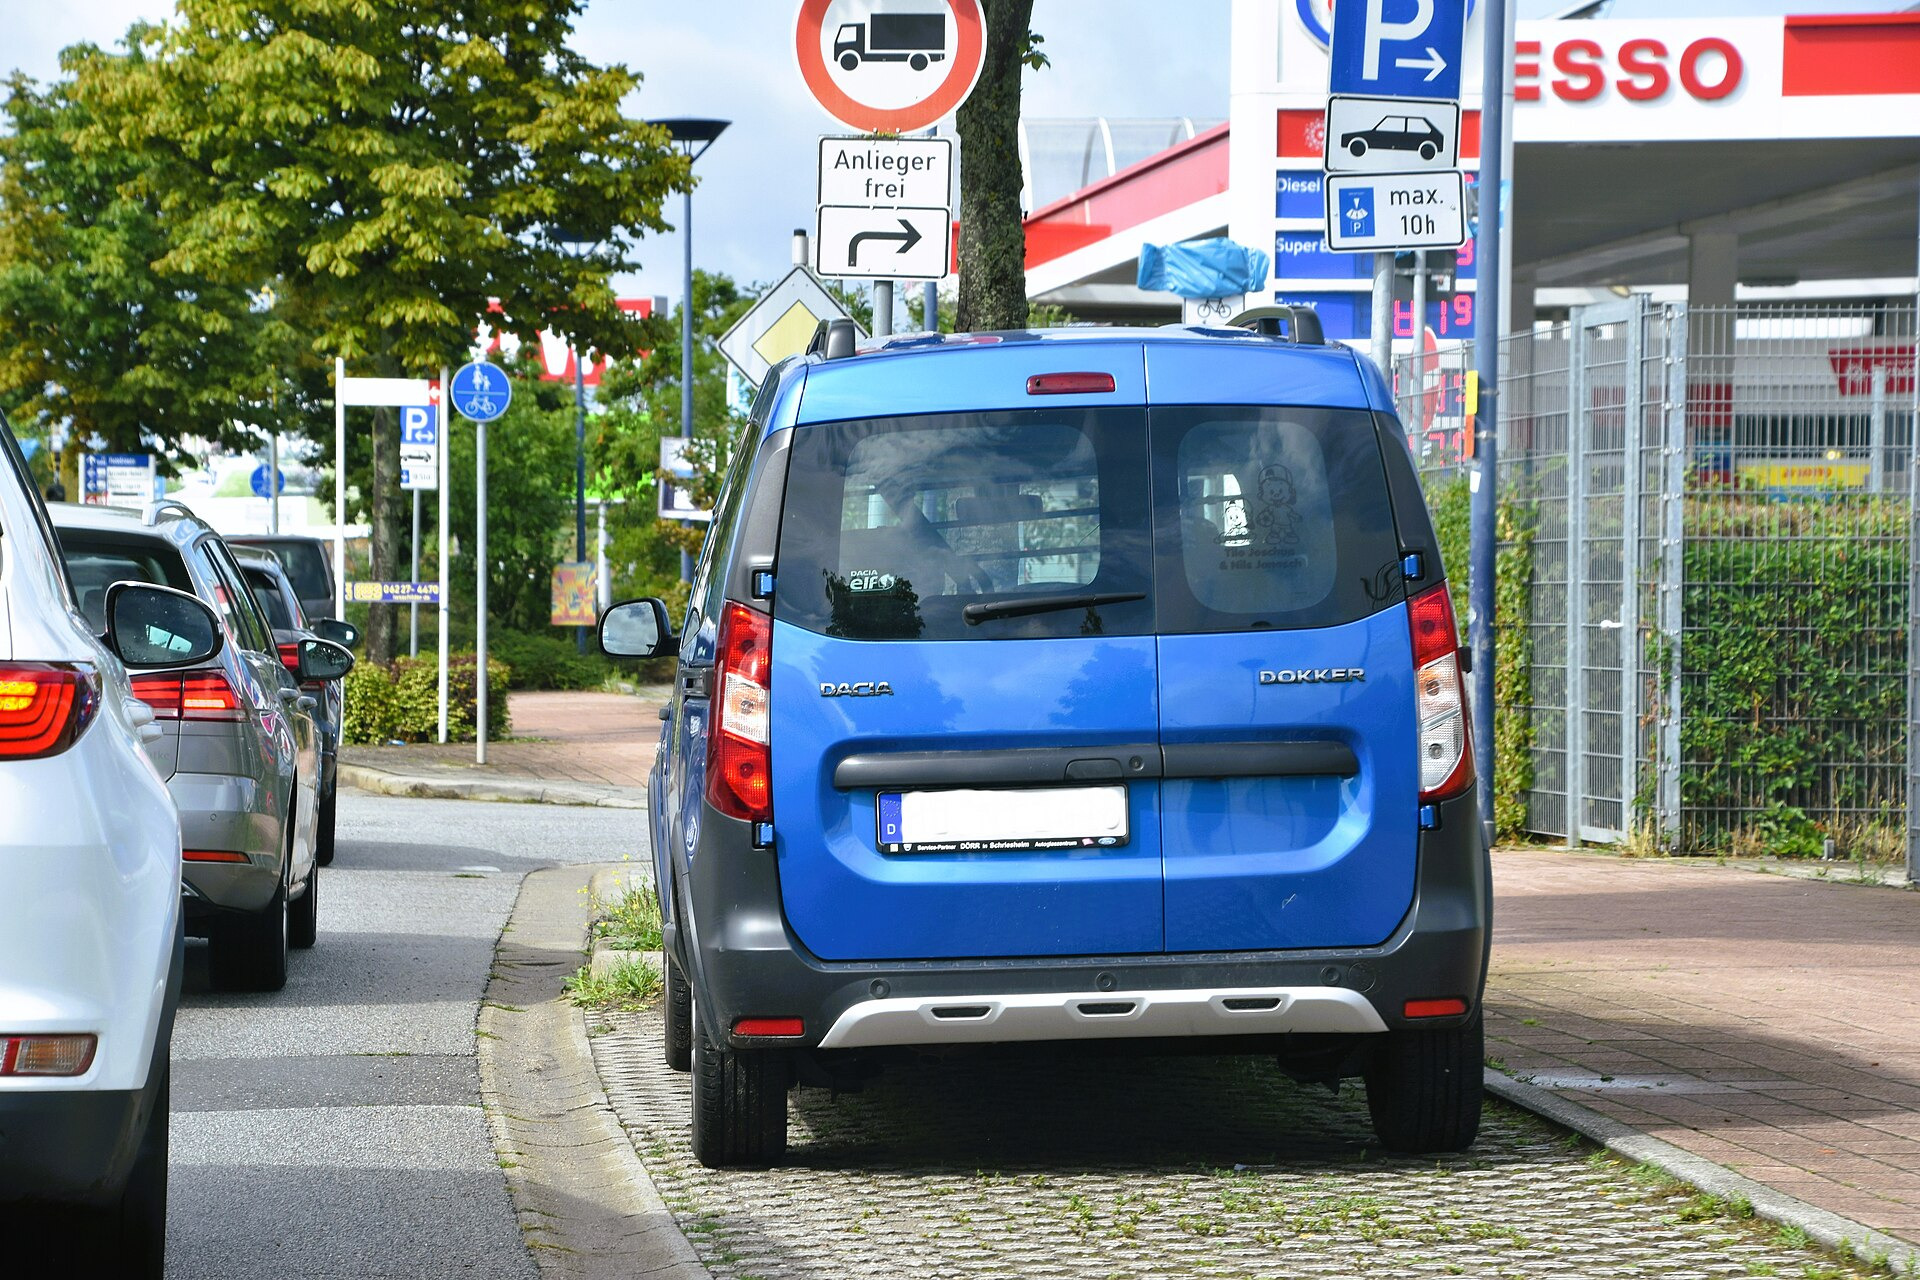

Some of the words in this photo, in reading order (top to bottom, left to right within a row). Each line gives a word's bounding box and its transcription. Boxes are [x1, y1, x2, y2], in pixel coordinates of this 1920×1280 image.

[1362, 0, 1434, 80] P
[834, 149, 936, 176] Anlieger
[865, 178, 904, 198] frei
[1277, 177, 1320, 192] Diesel
[1390, 189, 1444, 206] max.
[1400, 214, 1435, 235] 10h
[1276, 238, 1319, 256] Super
[405, 408, 428, 441] P
[850, 576, 878, 590] elf
[1260, 668, 1366, 684] DOKKER
[820, 681, 894, 697] DACIA
[887, 823, 896, 835] D
